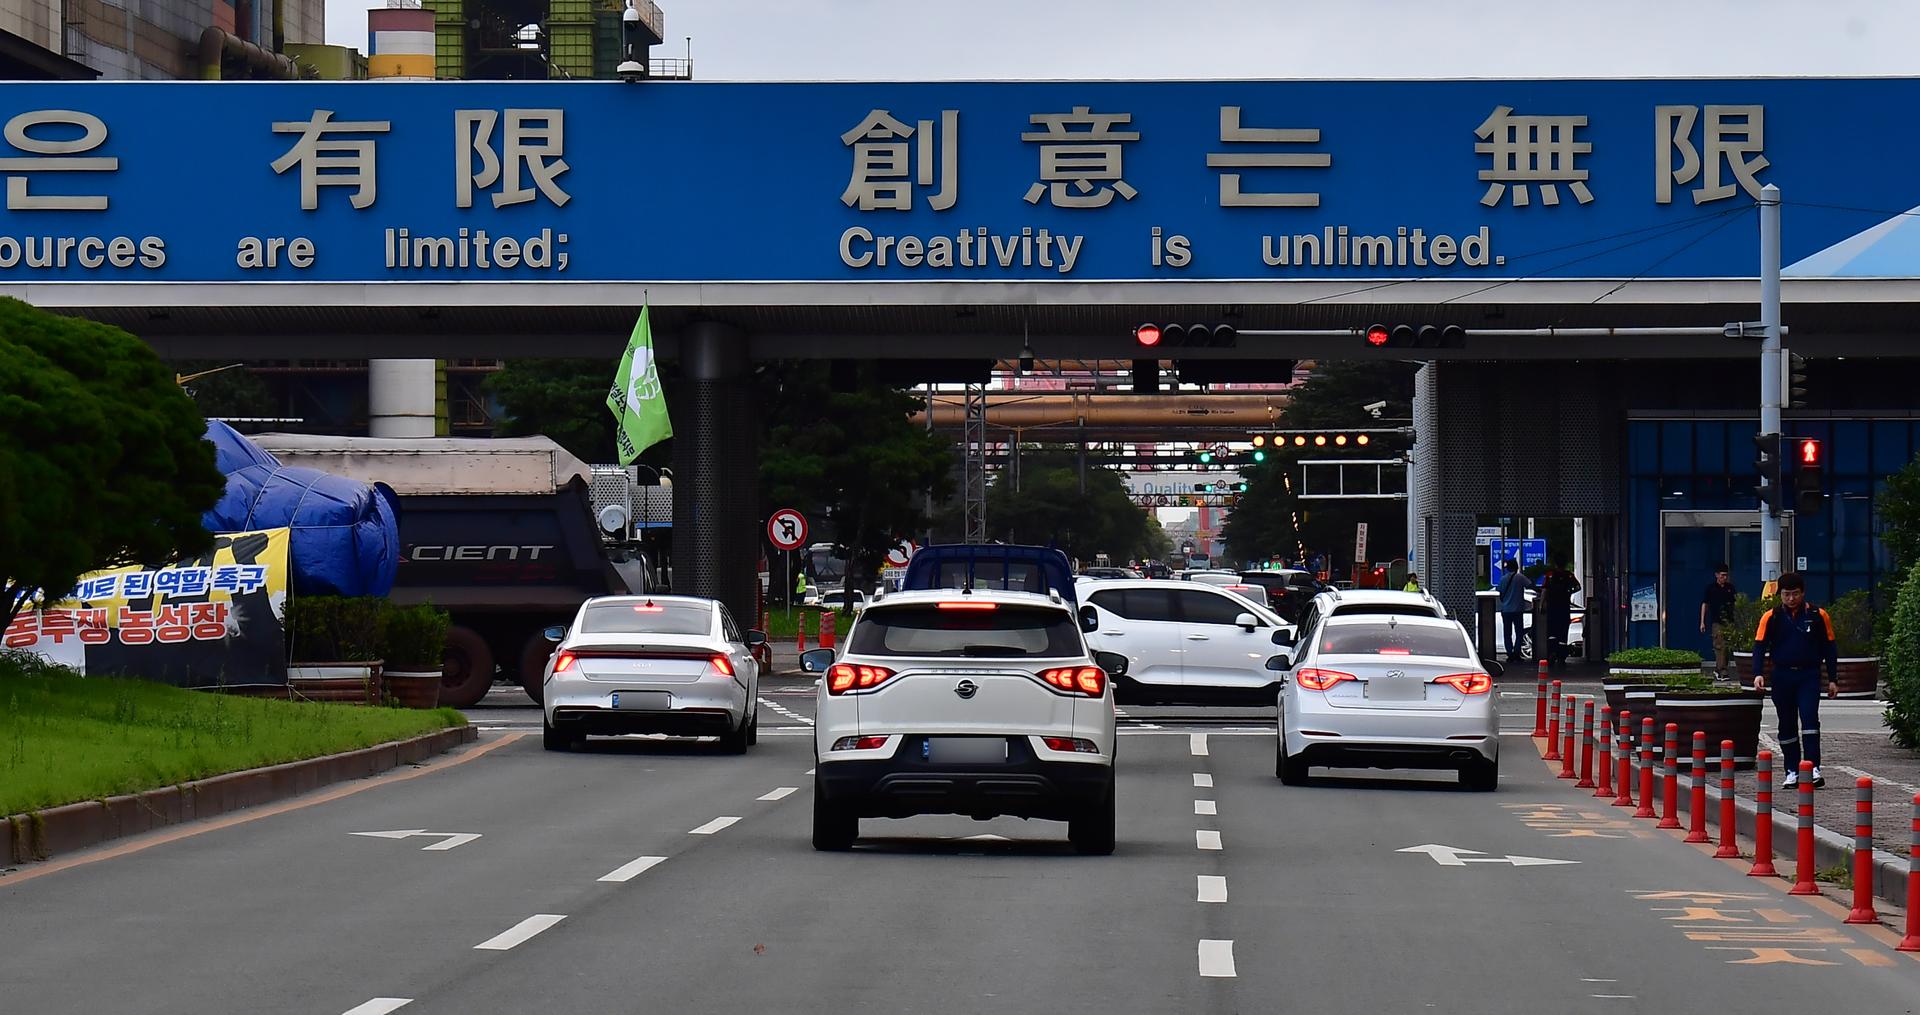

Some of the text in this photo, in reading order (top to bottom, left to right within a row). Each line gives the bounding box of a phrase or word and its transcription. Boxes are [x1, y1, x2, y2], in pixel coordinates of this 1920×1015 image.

[0, 110, 119, 210] 은
[0, 227, 1506, 274] ources are limited; Creativity is unlimited.
[1143, 482, 1196, 496] Quality
[399, 544, 554, 562] CIENT
[72, 576, 117, 600] 대로
[123, 574, 150, 597] 된
[157, 569, 208, 596] 역할
[213, 566, 265, 592] 촉구
[119, 602, 229, 643] 농성장
